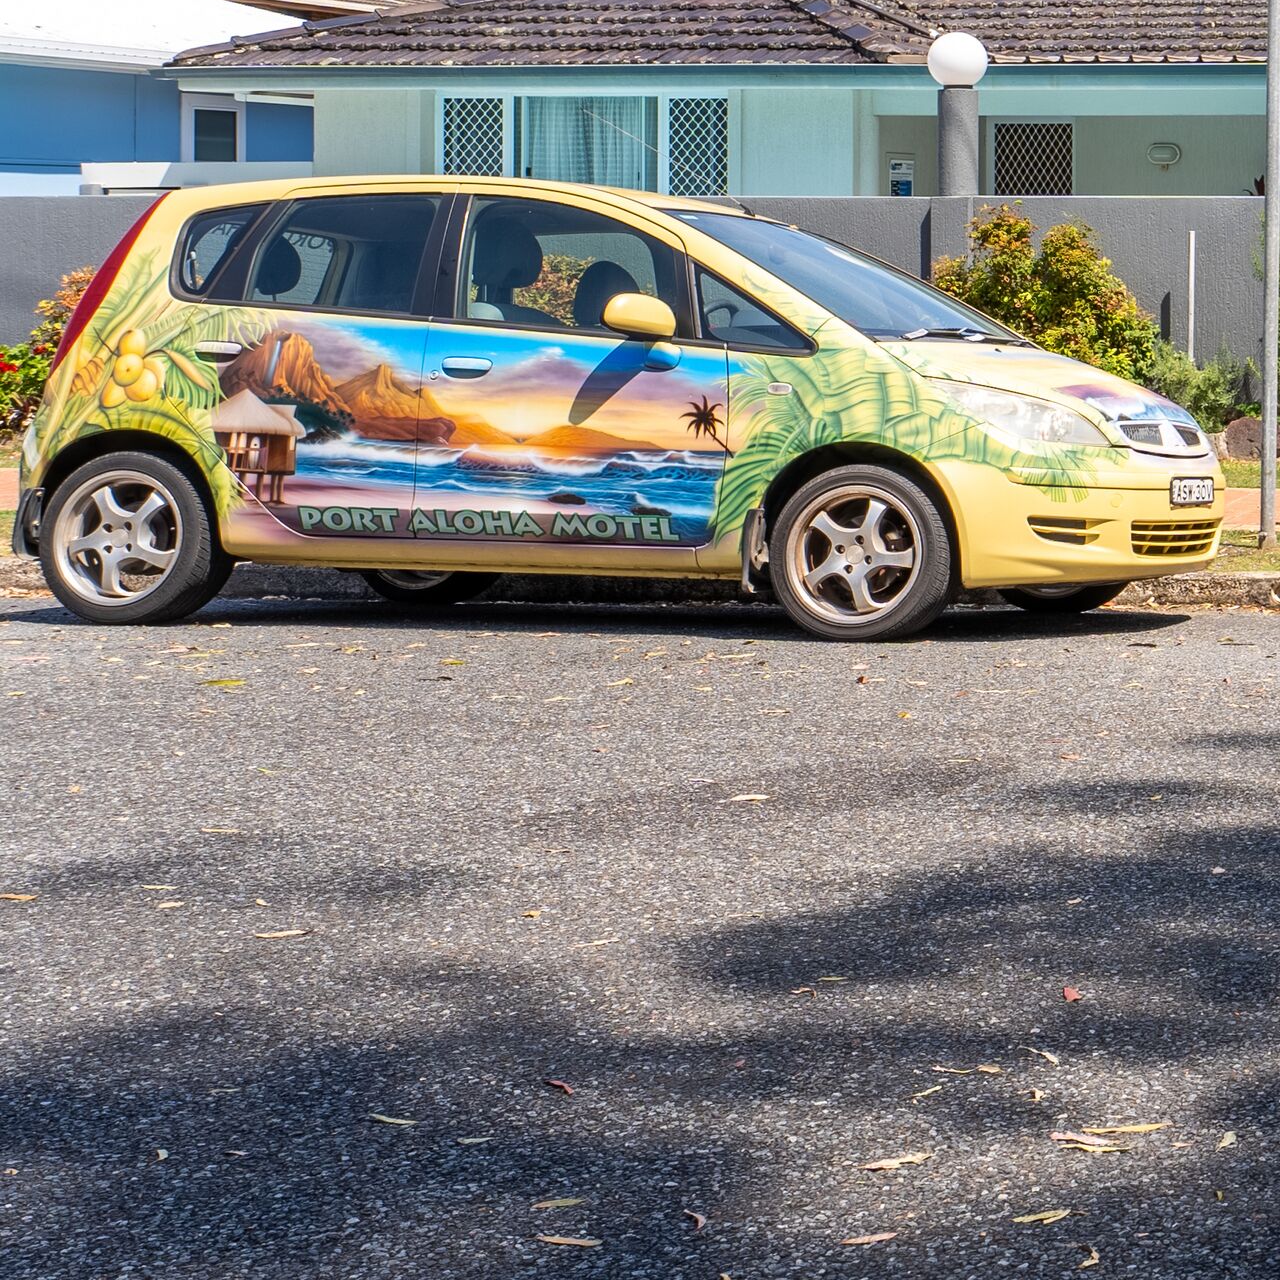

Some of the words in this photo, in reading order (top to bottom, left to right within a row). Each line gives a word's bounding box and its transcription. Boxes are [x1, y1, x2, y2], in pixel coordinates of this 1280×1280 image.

[299, 505, 398, 533] PORT
[408, 509, 545, 537] ALOHA
[550, 513, 680, 542] MOTEL
